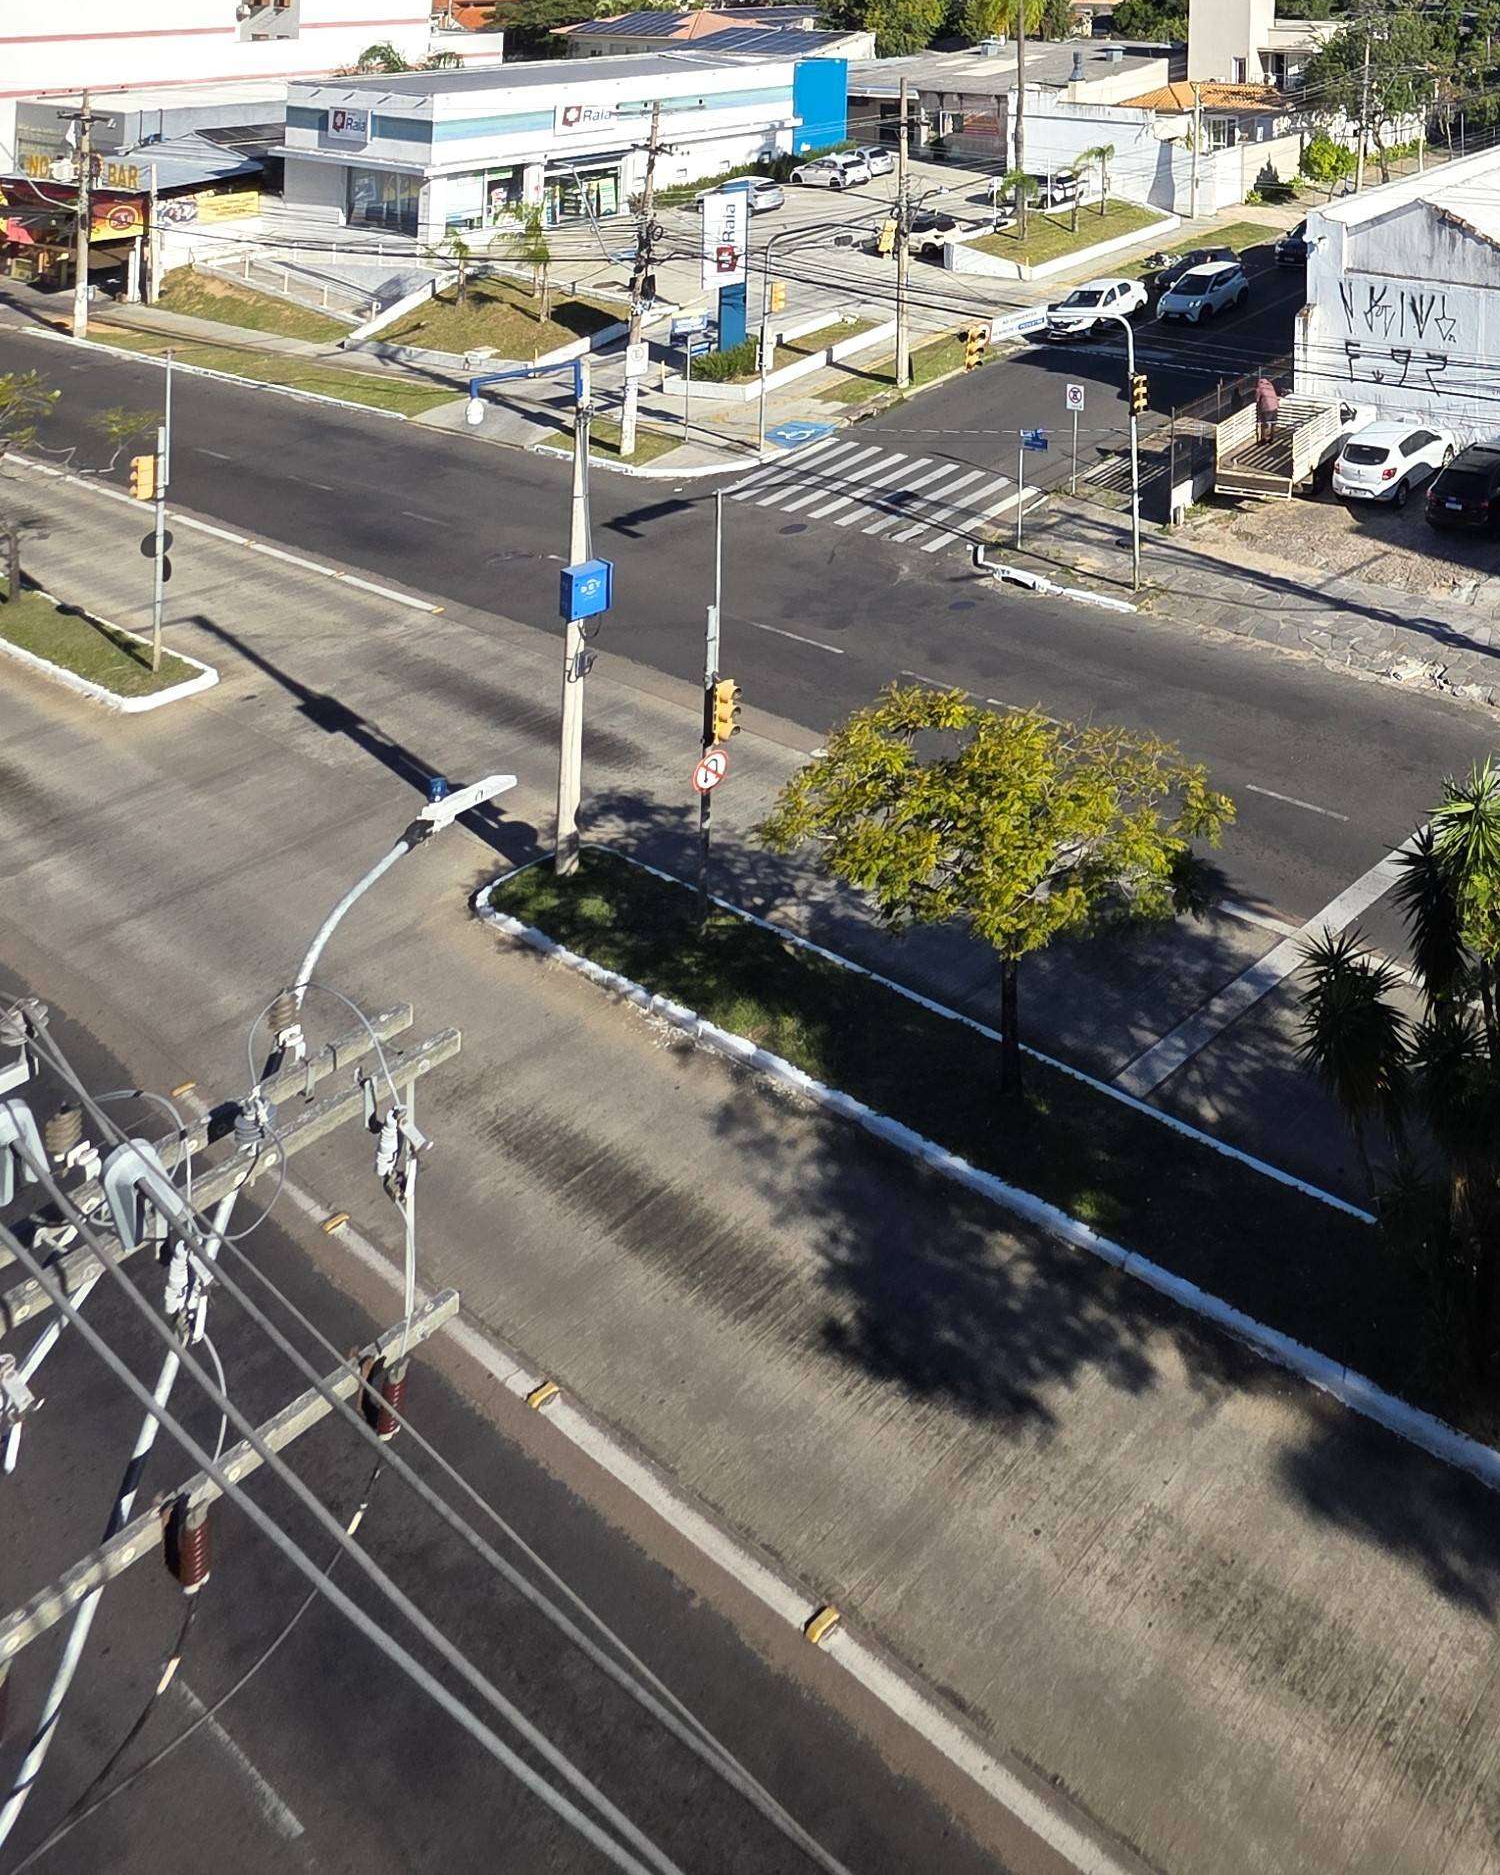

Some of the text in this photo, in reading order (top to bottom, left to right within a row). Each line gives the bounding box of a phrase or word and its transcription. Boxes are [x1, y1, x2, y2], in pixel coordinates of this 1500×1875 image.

[345, 117, 366, 133] Raia
[583, 108, 613, 123] Raia
[108, 163, 139, 189] BAR
[722, 203, 736, 243] Raia
